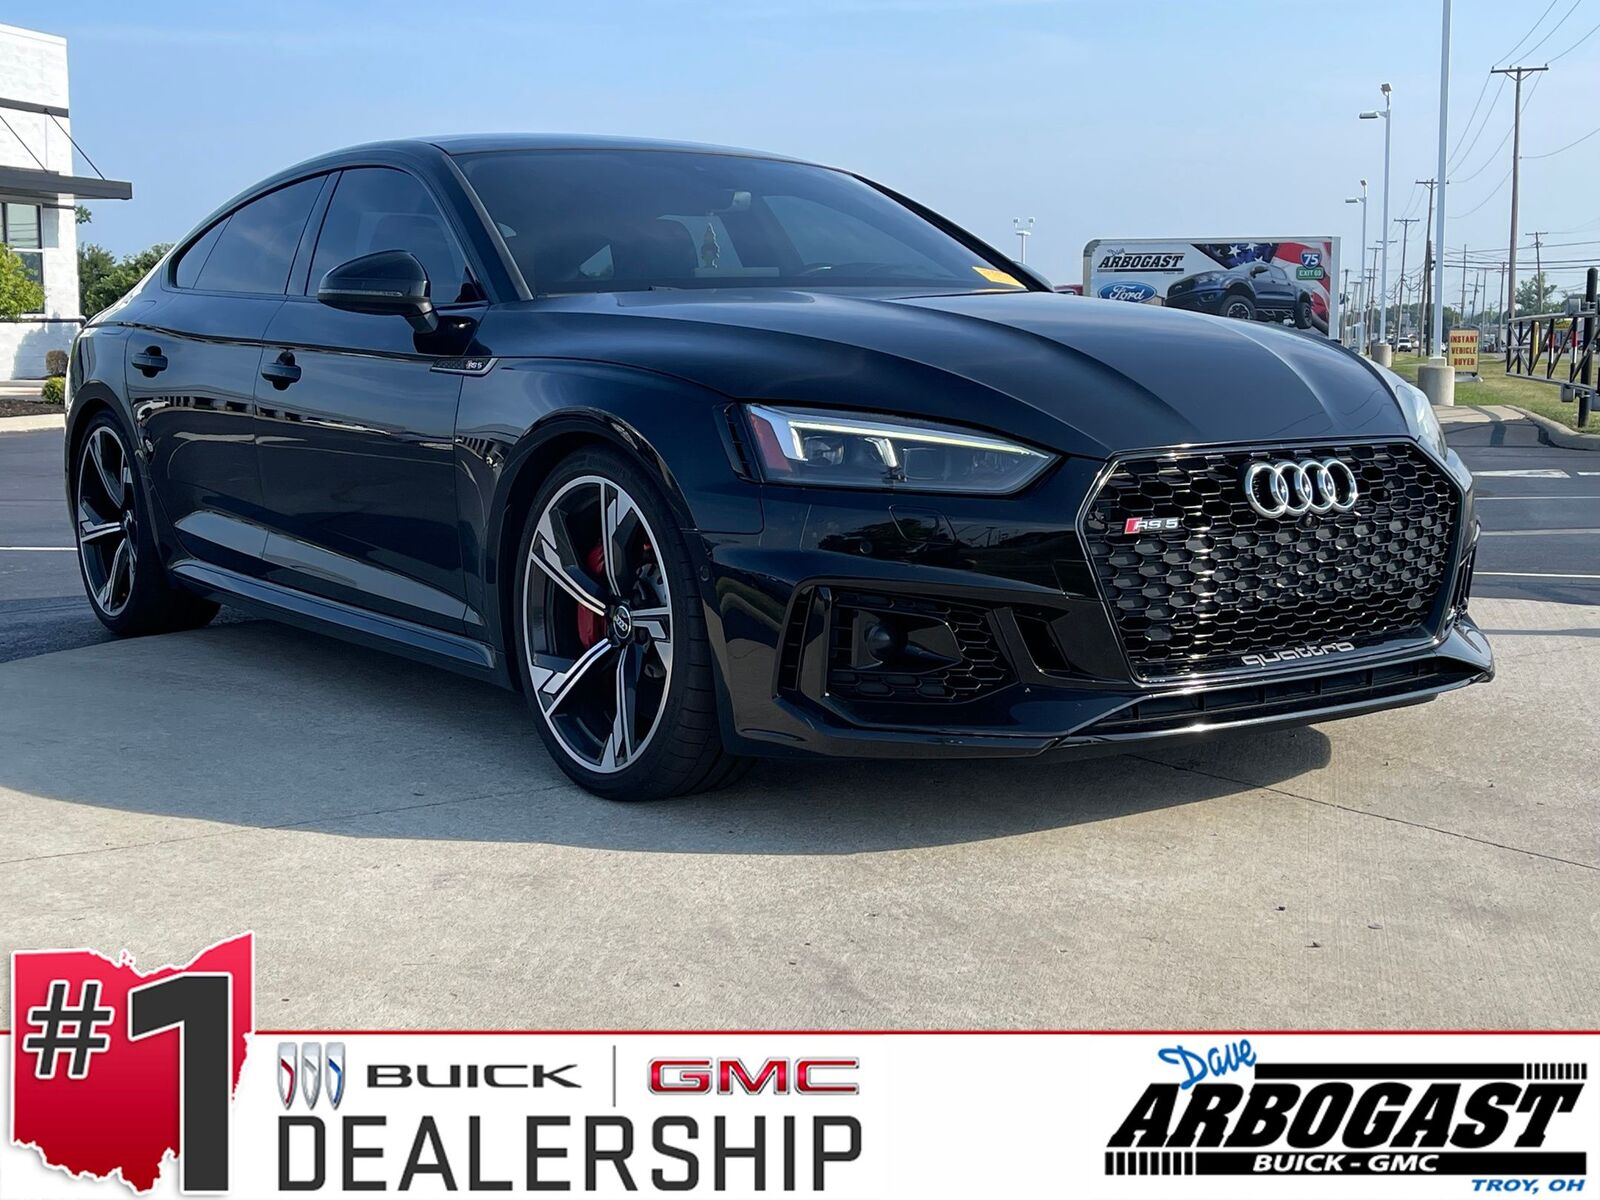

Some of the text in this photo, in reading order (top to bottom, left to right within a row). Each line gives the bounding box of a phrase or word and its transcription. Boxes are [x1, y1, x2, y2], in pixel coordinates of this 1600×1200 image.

[1098, 255, 1184, 269] ARBOGAST
[1303, 254, 1319, 265] 75
[1300, 269, 1313, 277] EXIT
[1109, 285, 1146, 300] Ford
[1450, 335, 1478, 344] INSTANT
[1451, 346, 1476, 355] VEHICLE
[1454, 357, 1475, 366] BUYER
[1241, 641, 1355, 667] quattro
